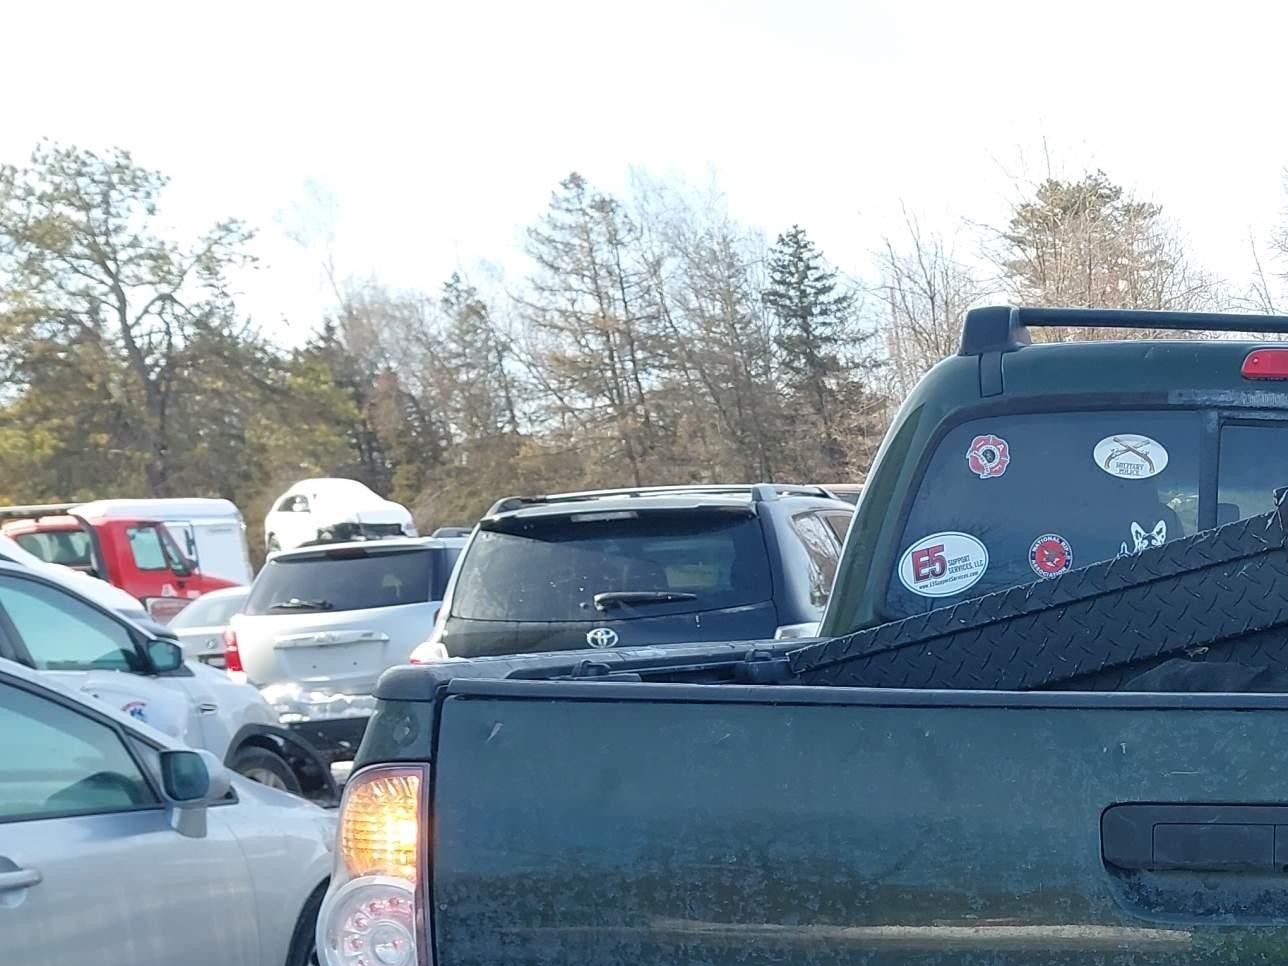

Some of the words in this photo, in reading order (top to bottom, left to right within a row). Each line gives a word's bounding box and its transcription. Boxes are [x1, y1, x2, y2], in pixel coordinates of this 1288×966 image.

[911, 544, 947, 584] E5
[947, 554, 970, 567] SUPPORT
[974, 559, 985, 568] LLC
